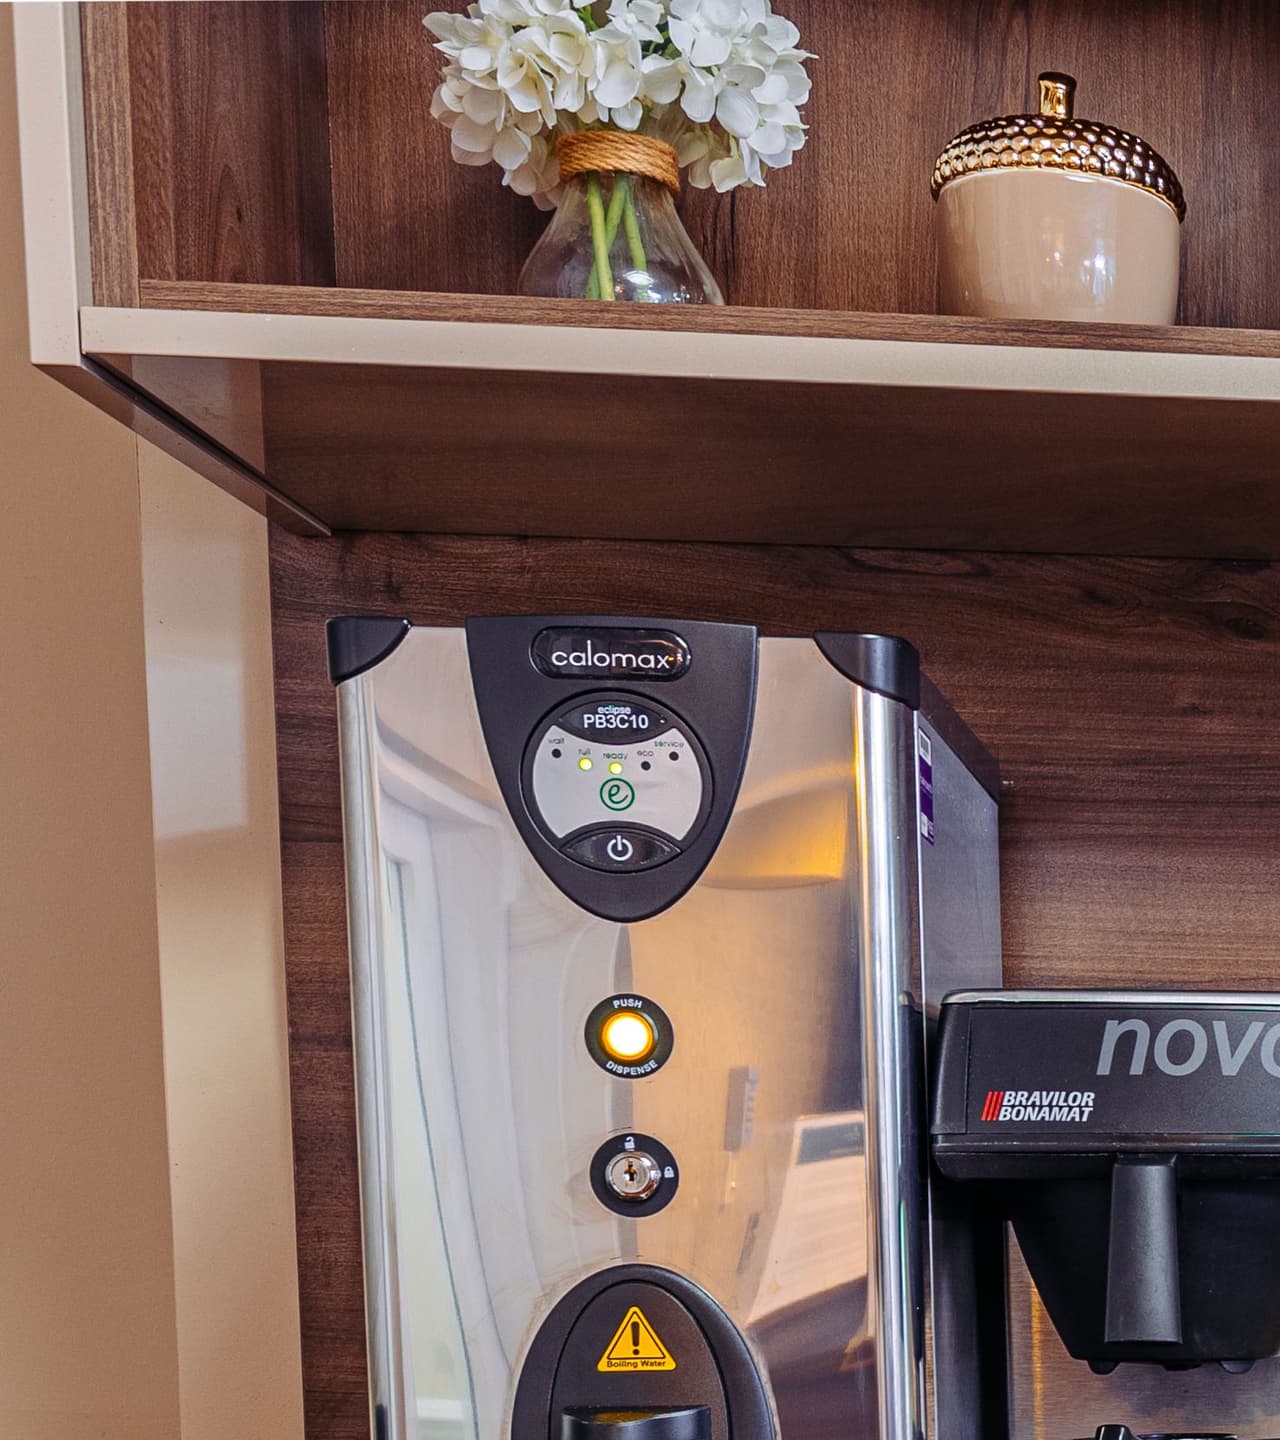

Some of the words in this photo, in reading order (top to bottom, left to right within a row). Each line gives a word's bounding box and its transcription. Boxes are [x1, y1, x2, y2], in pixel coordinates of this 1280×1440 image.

[551, 639, 671, 670] calomax
[597, 705, 632, 716] eclipse
[583, 714, 649, 729] PB3C10
[548, 737, 565, 745] wait
[653, 740, 685, 748] service
[602, 752, 629, 761] ready
[612, 998, 643, 1009] PUSH
[605, 1059, 658, 1076] DISPENSE
[1002, 1090, 1096, 1107] BRAVILOR
[998, 1105, 1094, 1122] BONAMAT
[606, 1360, 639, 1369] Boiling
[640, 1360, 666, 1368] Water
